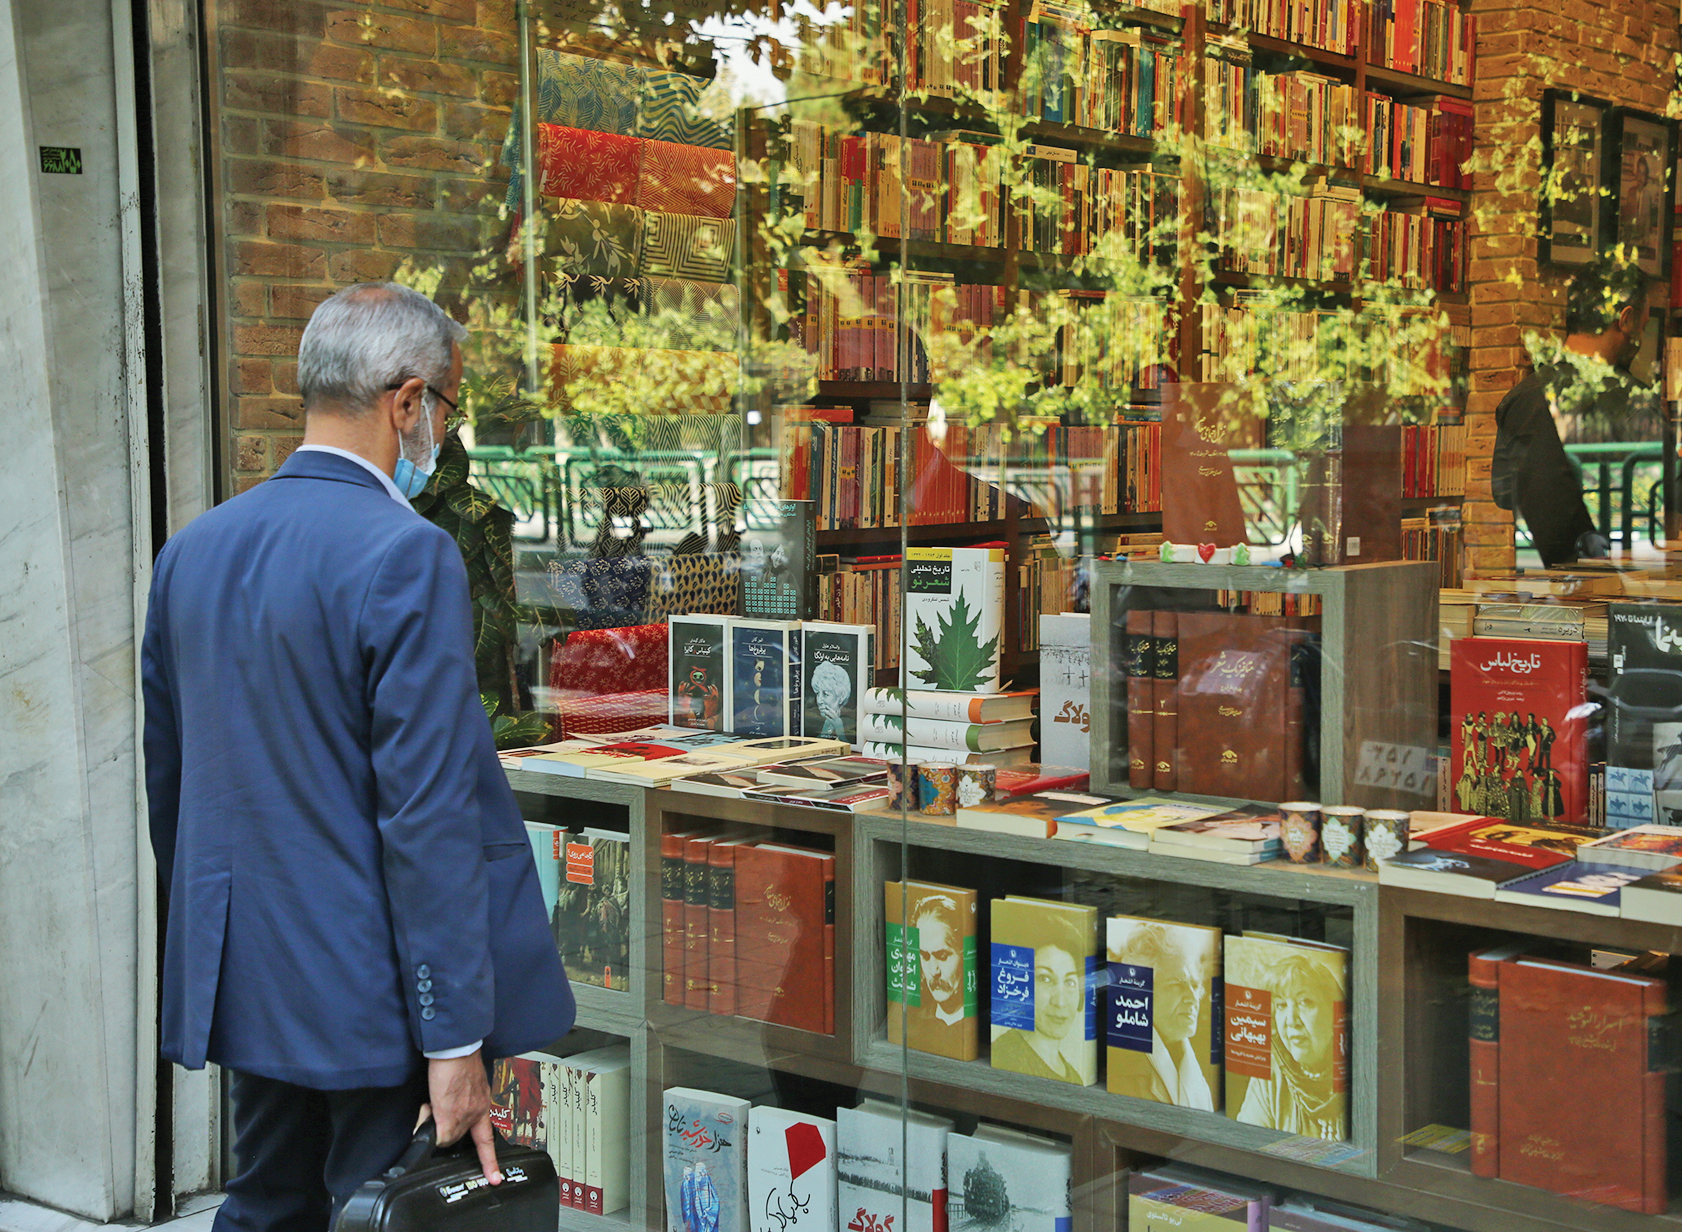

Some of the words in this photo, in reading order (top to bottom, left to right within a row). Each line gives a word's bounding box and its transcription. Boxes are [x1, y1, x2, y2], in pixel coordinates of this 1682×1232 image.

[910, 564, 932, 574] تحلیلی
[932, 565, 950, 576] تاریخ
[911, 576, 922, 590] نو
[922, 576, 950, 590] شعر
[1480, 652, 1512, 672] لباس
[1511, 652, 1541, 674] تاریخ
[1053, 700, 1090, 733] ولاگ
[998, 967, 1030, 984] فروغ
[890, 978, 916, 991] ثلث
[997, 984, 1030, 1002] فرخزاد
[1115, 995, 1149, 1010] احمد
[1115, 1010, 1149, 1028] شاملو
[1230, 1015, 1266, 1028] سیمین
[1230, 1027, 1266, 1046] بهبهانی
[490, 1108, 511, 1120] کلیدر
[668, 1104, 687, 1136] تابان
[679, 1119, 713, 1148] خورشید
[706, 1130, 732, 1154] هزار
